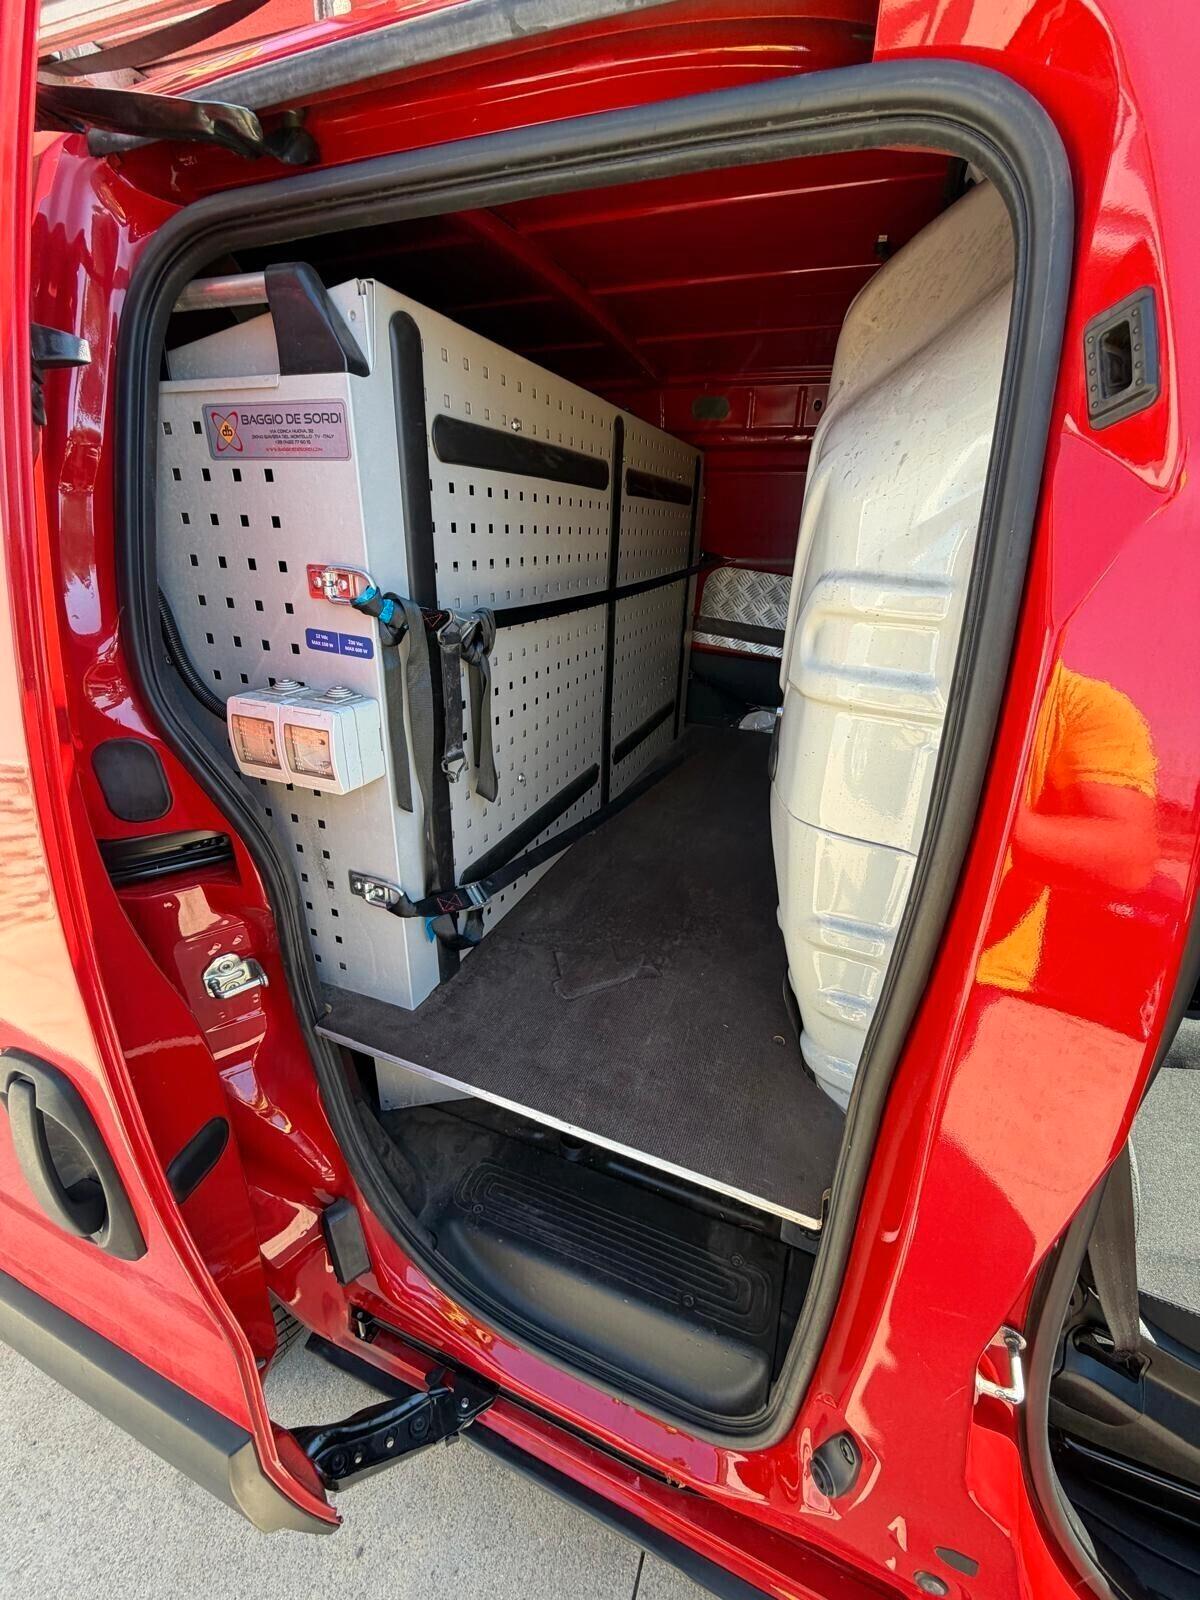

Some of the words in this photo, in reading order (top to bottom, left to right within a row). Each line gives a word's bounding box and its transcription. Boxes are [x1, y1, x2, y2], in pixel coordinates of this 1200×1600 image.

[241, 414, 284, 425] BAGGIO
[285, 413, 302, 425] DE
[303, 412, 342, 425] SORDI
